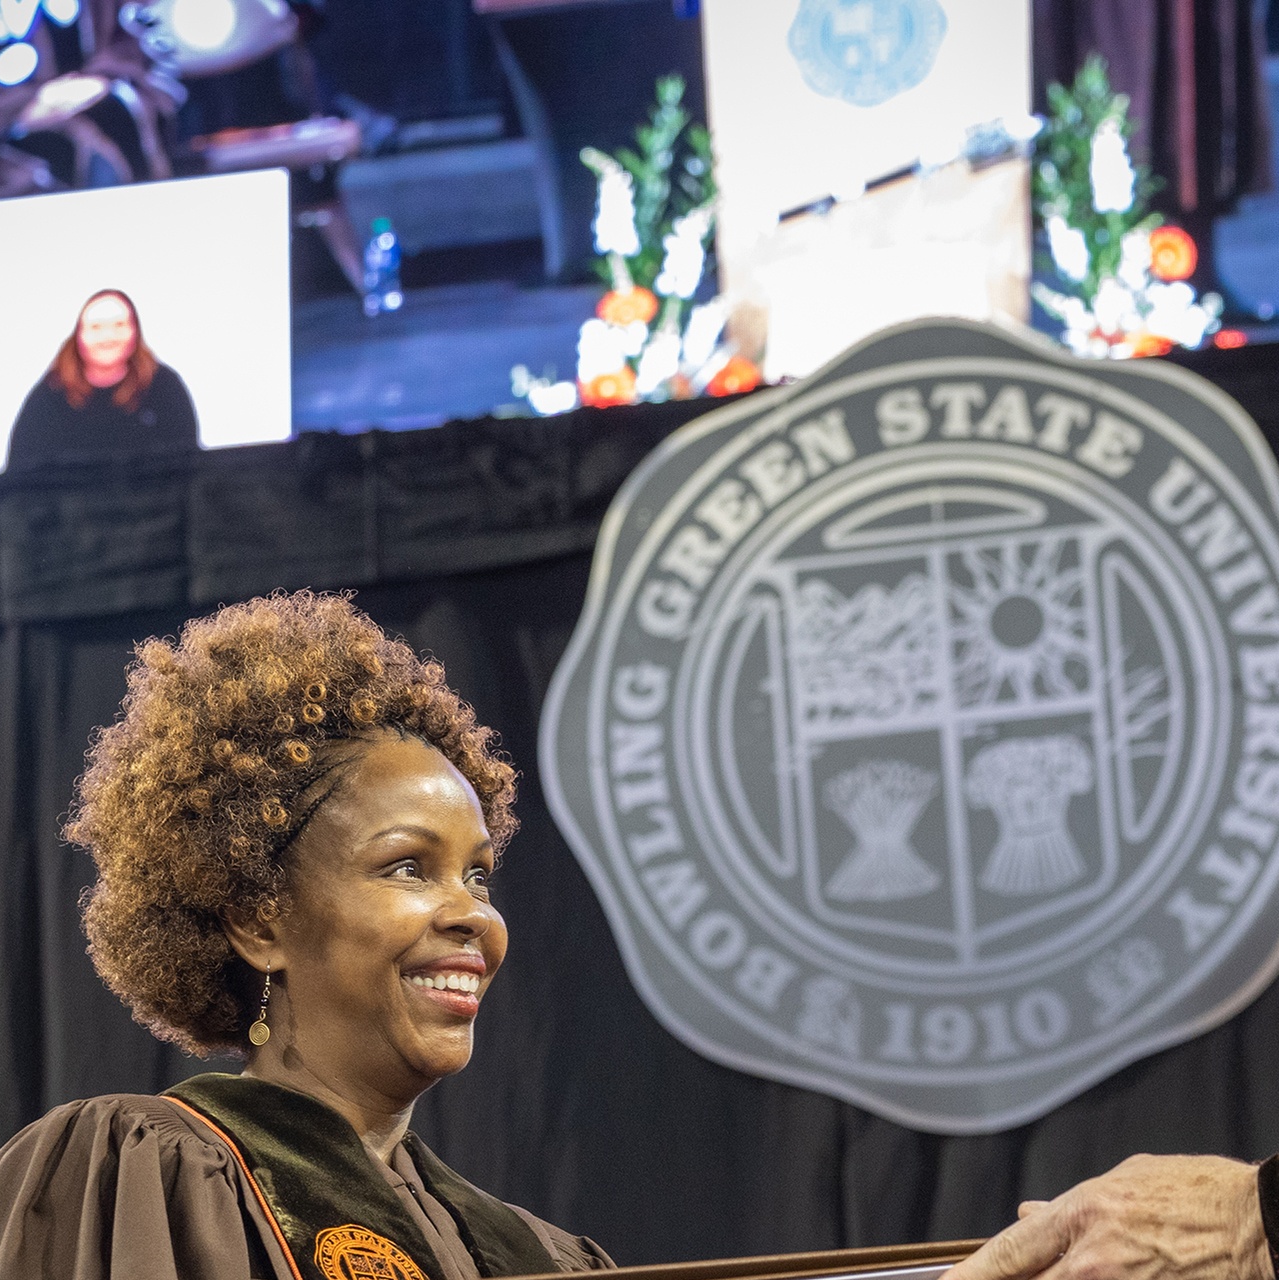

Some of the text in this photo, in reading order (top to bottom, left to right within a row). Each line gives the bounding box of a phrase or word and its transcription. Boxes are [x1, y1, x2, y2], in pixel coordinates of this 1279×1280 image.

[874, 382, 1145, 478] STATE
[638, 406, 858, 640] GREEN
[610, 658, 798, 1006] BOWLING
[883, 1002, 1072, 1064] 1910
